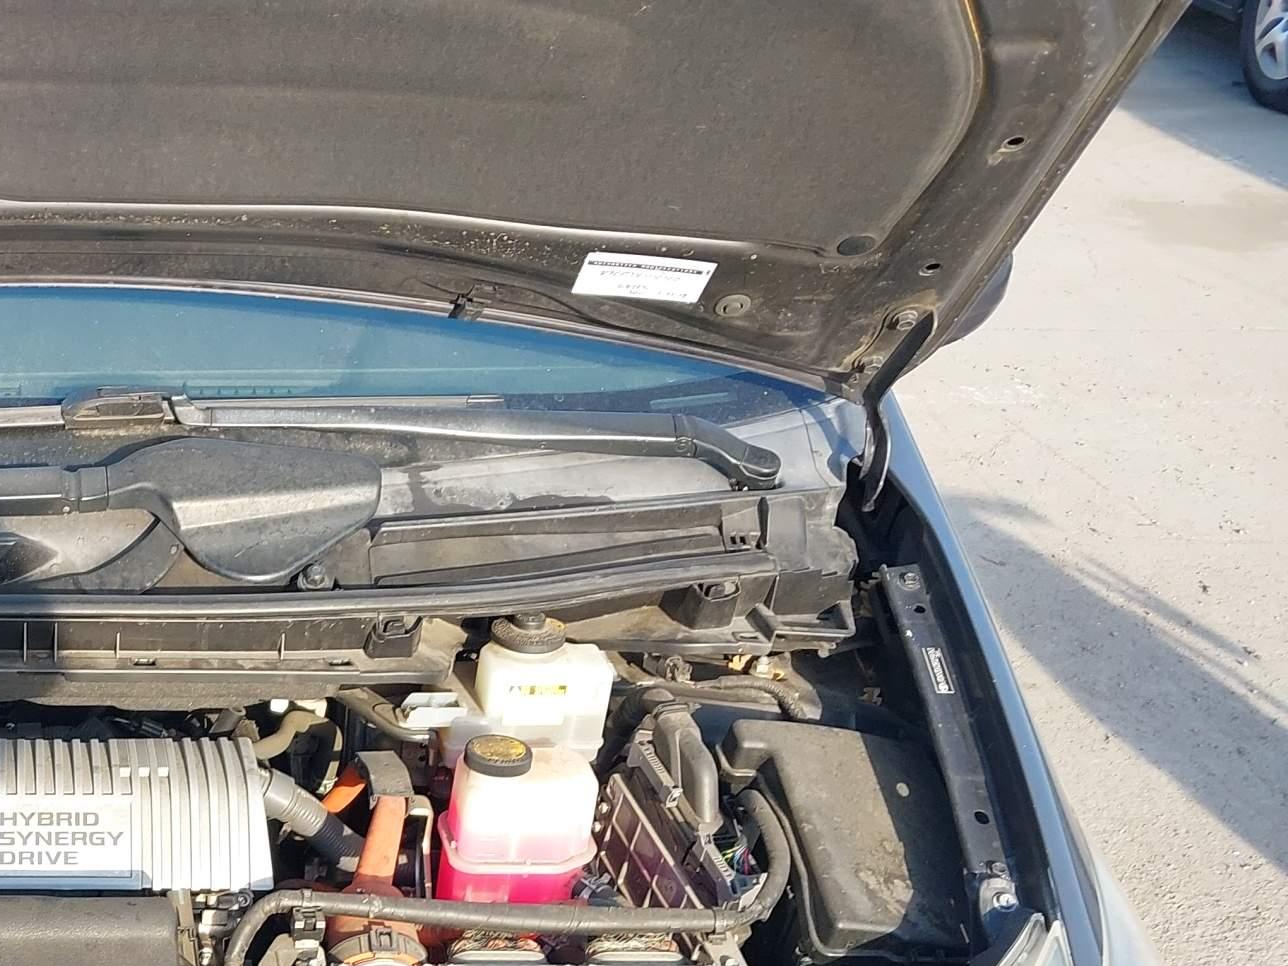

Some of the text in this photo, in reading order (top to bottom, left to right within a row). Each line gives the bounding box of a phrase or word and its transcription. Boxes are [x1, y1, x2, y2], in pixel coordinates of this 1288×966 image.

[0, 812, 99, 826] HYBRID
[0, 831, 124, 846] SYNERGY
[0, 851, 79, 865] DRIVE
